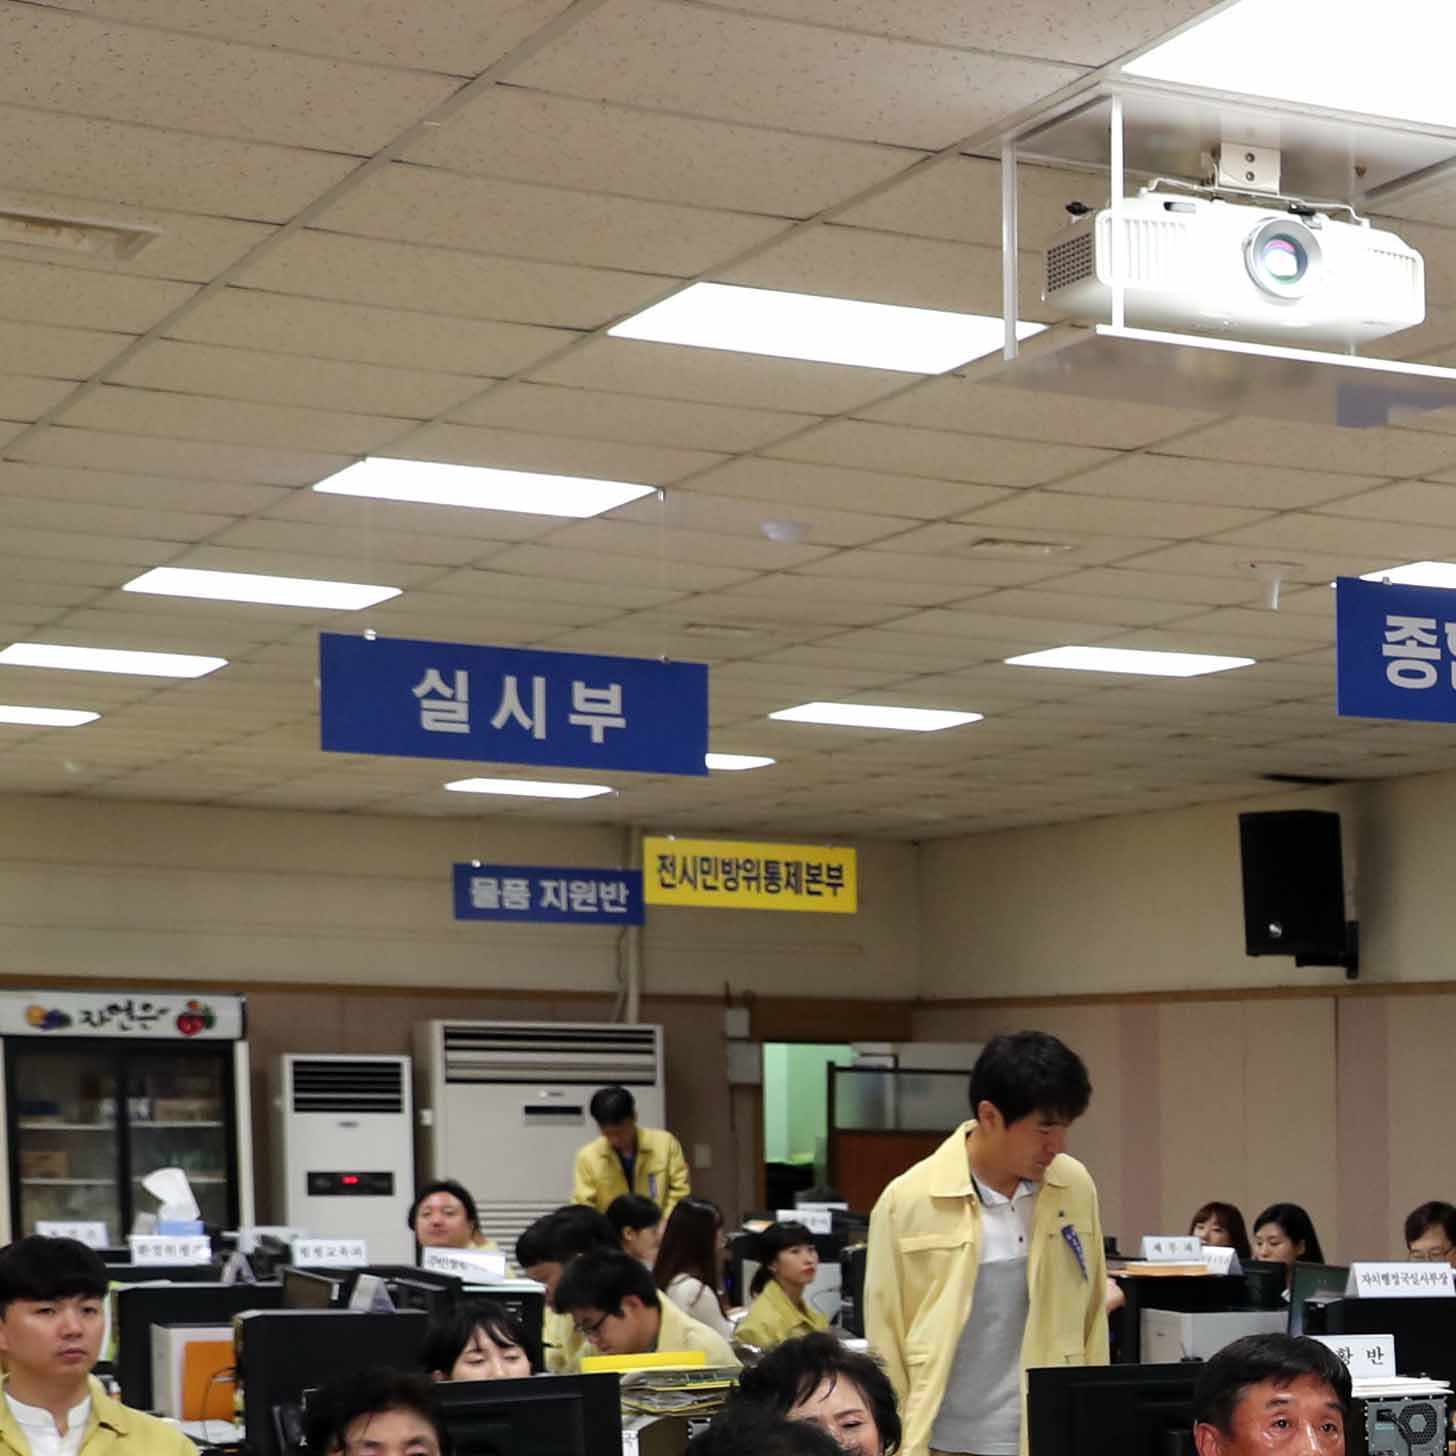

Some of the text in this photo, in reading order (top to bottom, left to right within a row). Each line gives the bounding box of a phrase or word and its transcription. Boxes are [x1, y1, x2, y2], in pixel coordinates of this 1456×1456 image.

[470, 876, 629, 913] 물품 지원반
[656, 854, 845, 898] 전시민방위통제본부
